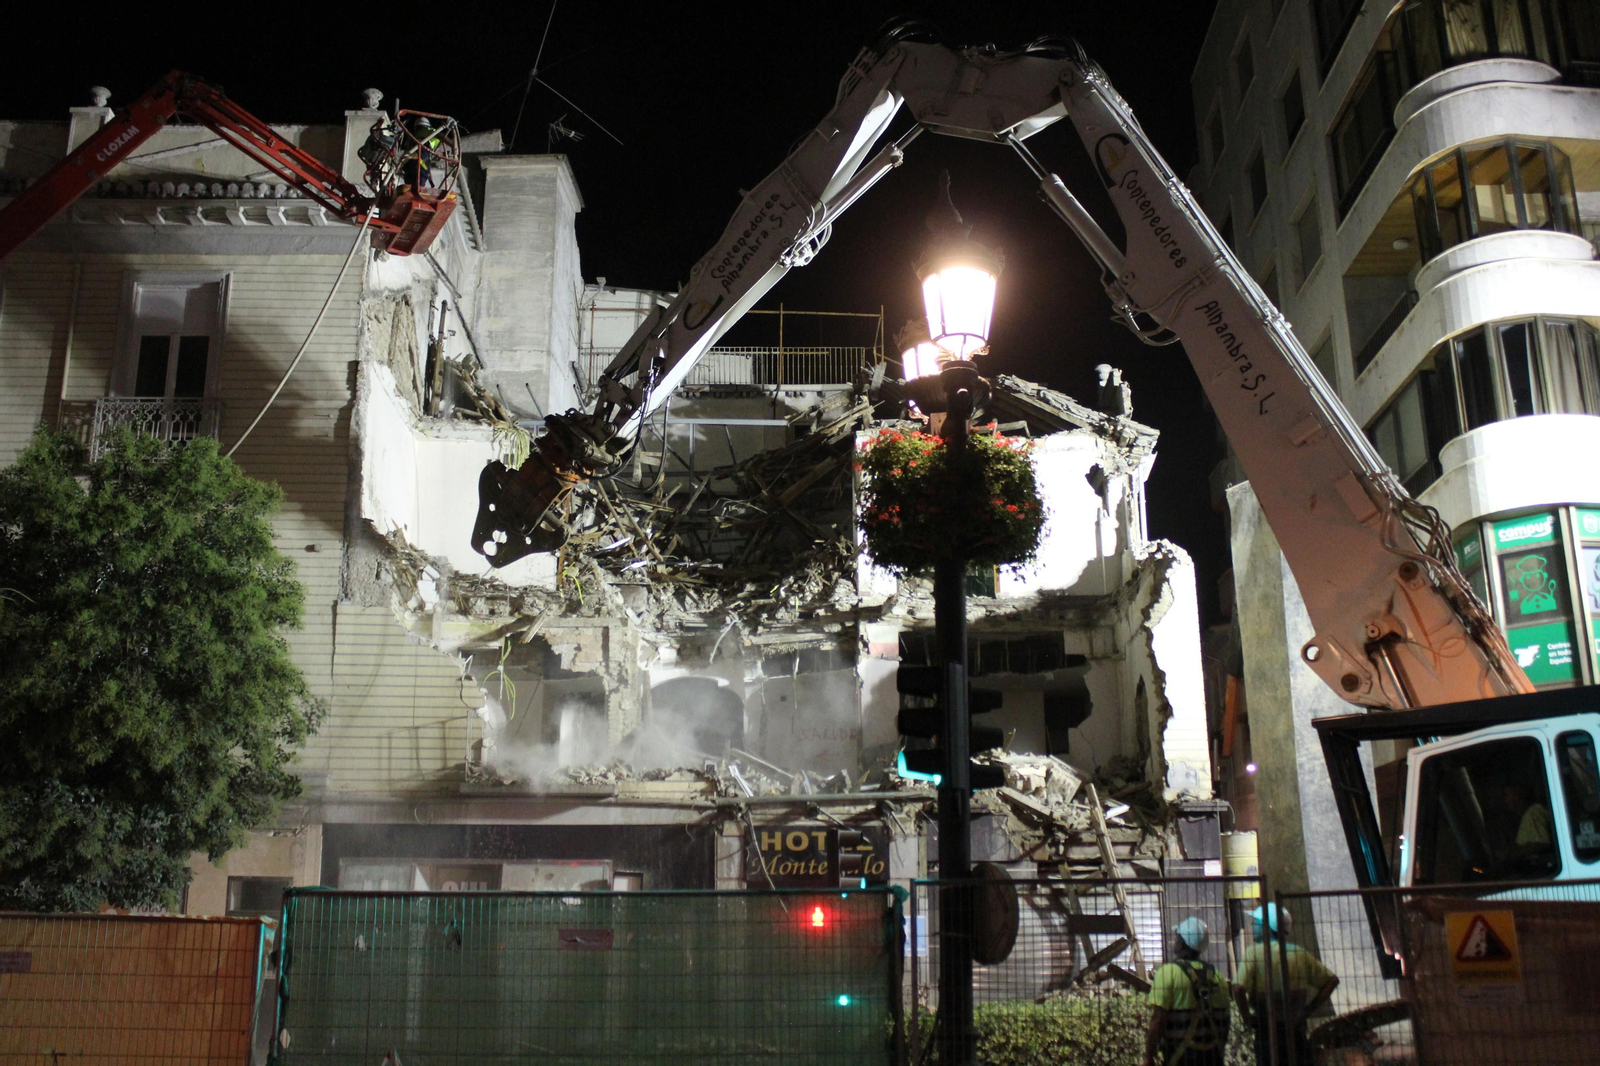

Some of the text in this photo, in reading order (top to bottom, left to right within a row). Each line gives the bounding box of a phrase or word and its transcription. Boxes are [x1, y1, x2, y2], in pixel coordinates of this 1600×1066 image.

[103, 125, 140, 157] LOXAM
[1119, 169, 1187, 269] Contenedores
[711, 193, 780, 279] Contenedores
[761, 831, 873, 852] HOT
[750, 853, 828, 876] Monte
